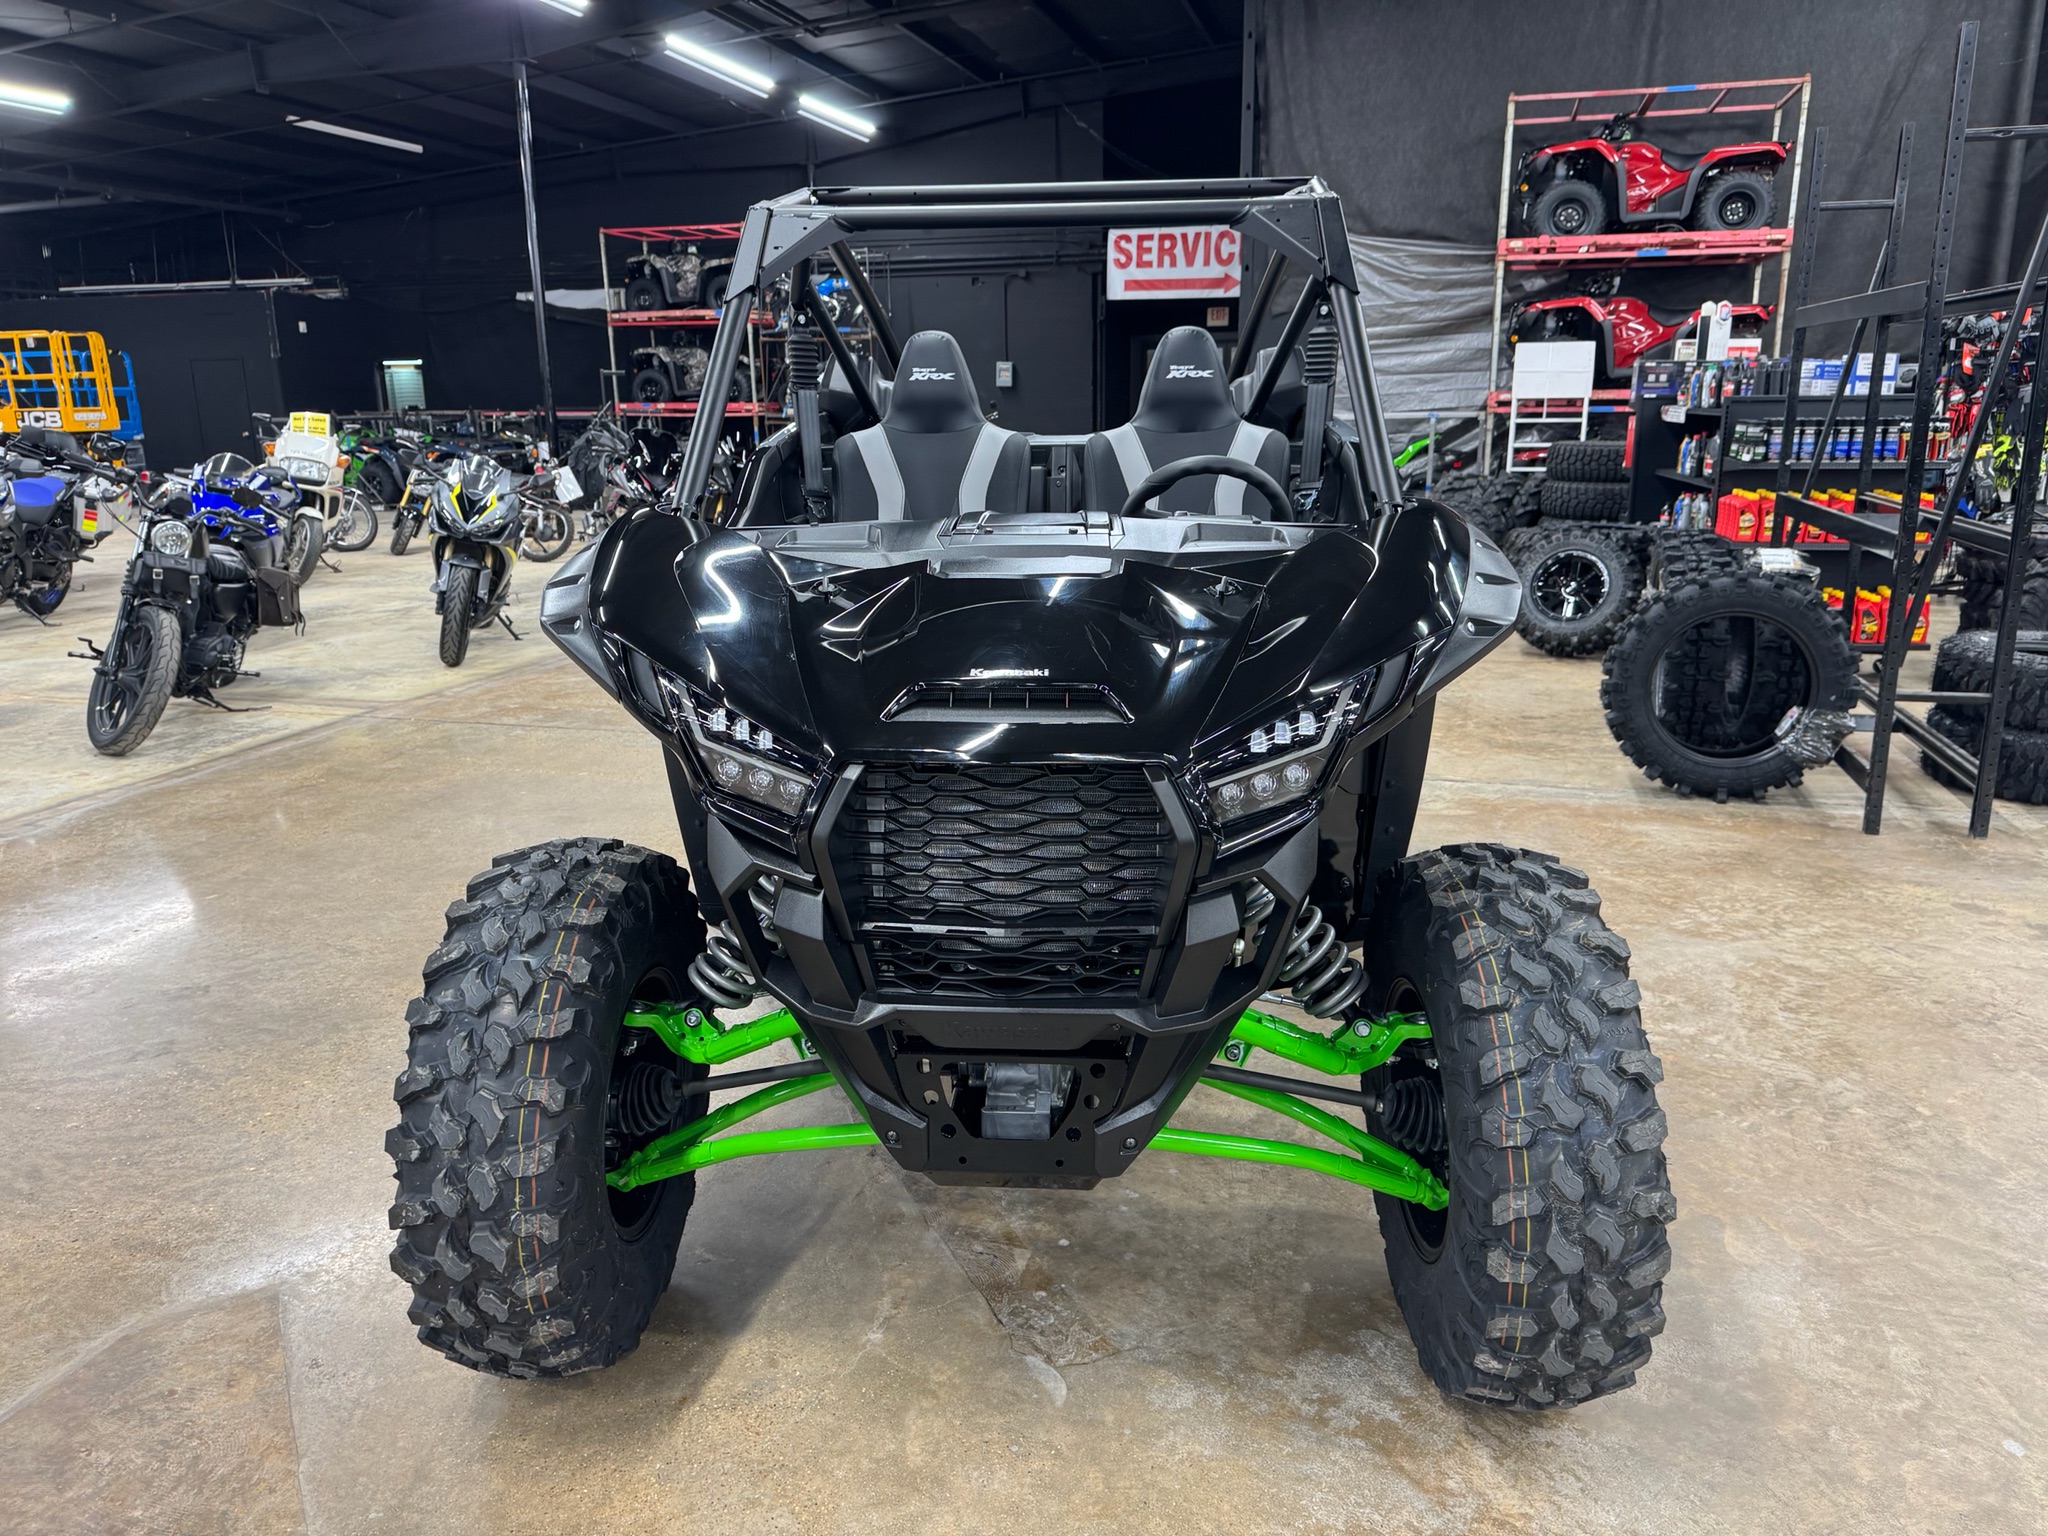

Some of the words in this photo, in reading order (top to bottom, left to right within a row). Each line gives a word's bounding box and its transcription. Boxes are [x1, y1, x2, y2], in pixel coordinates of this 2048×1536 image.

[1113, 230, 1242, 270] SERVIC
[17, 411, 63, 428] JCB
[969, 668, 1050, 677] Kawasaki
